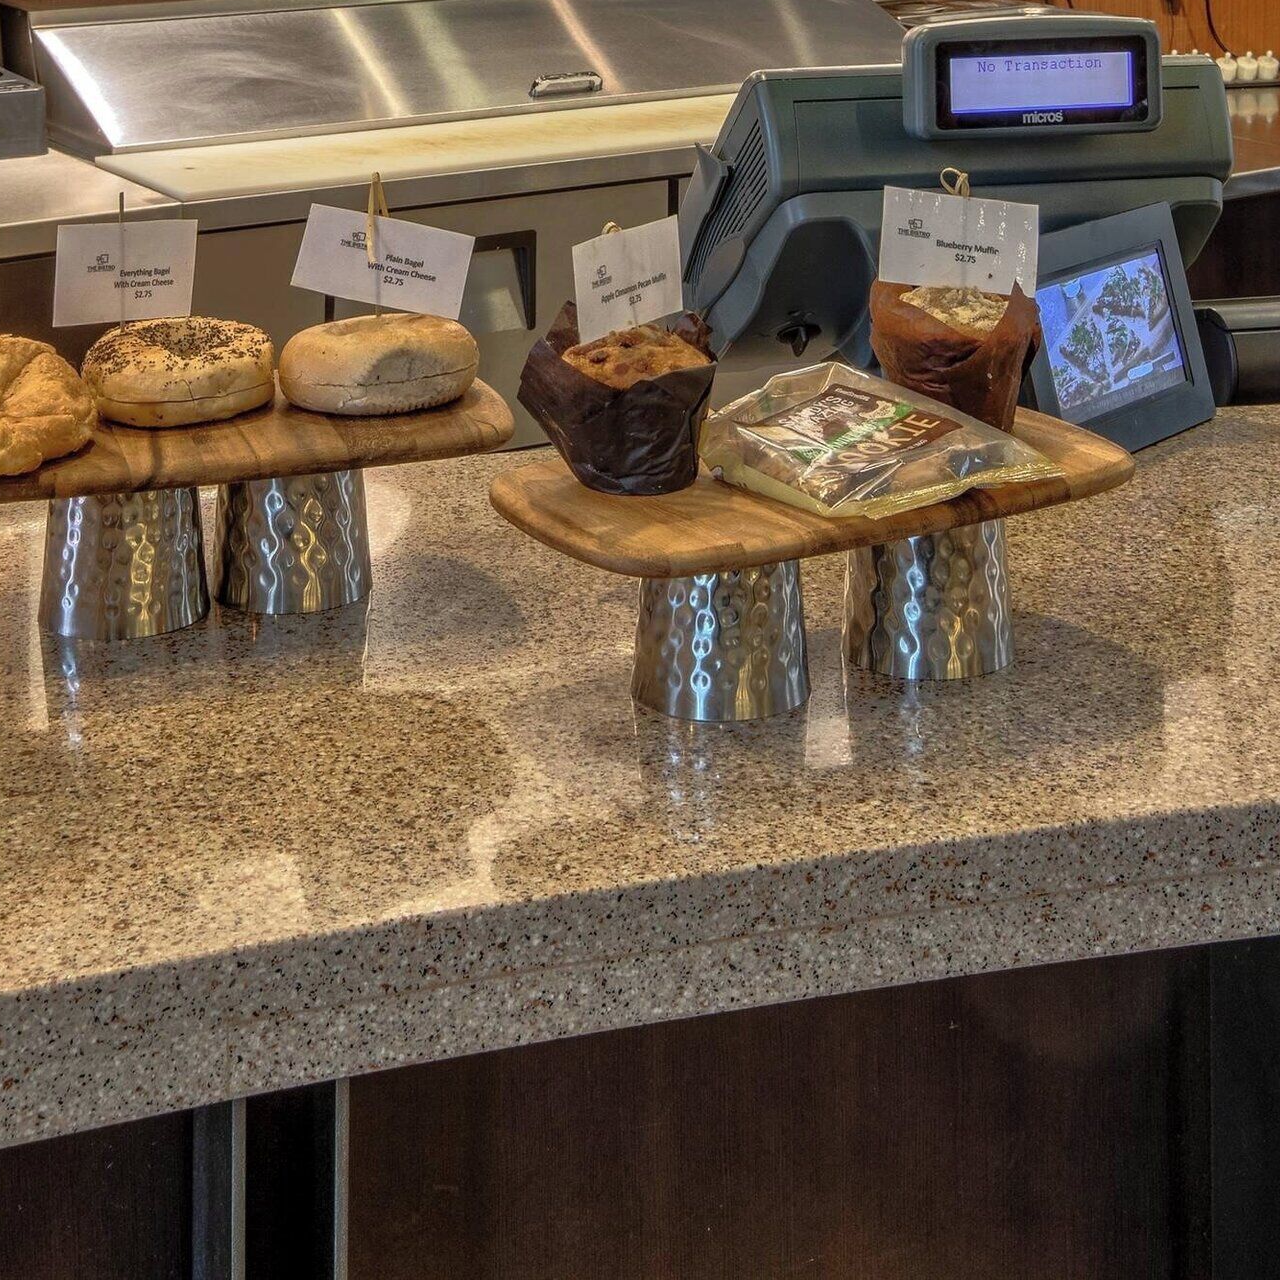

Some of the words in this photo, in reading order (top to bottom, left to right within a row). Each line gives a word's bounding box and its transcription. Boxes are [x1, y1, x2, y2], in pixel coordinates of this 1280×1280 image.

[978, 62, 995, 72] No
[1005, 59, 1102, 71] Transaction
[1022, 111, 1063, 124] micros
[936, 240, 973, 252] Blueberry
[385, 254, 403, 263] Plain
[404, 258, 424, 268] Bagel
[955, 254, 976, 264] $2.75
[120, 268, 152, 278] Everything
[154, 267, 170, 276] Bagel
[367, 262, 384, 271] With
[386, 266, 409, 276] Cream
[410, 270, 436, 282] Cheese
[114, 281, 129, 289] With
[152, 278, 174, 286] Cheese
[384, 275, 404, 286] $2.75
[135, 290, 152, 299] $2.75
